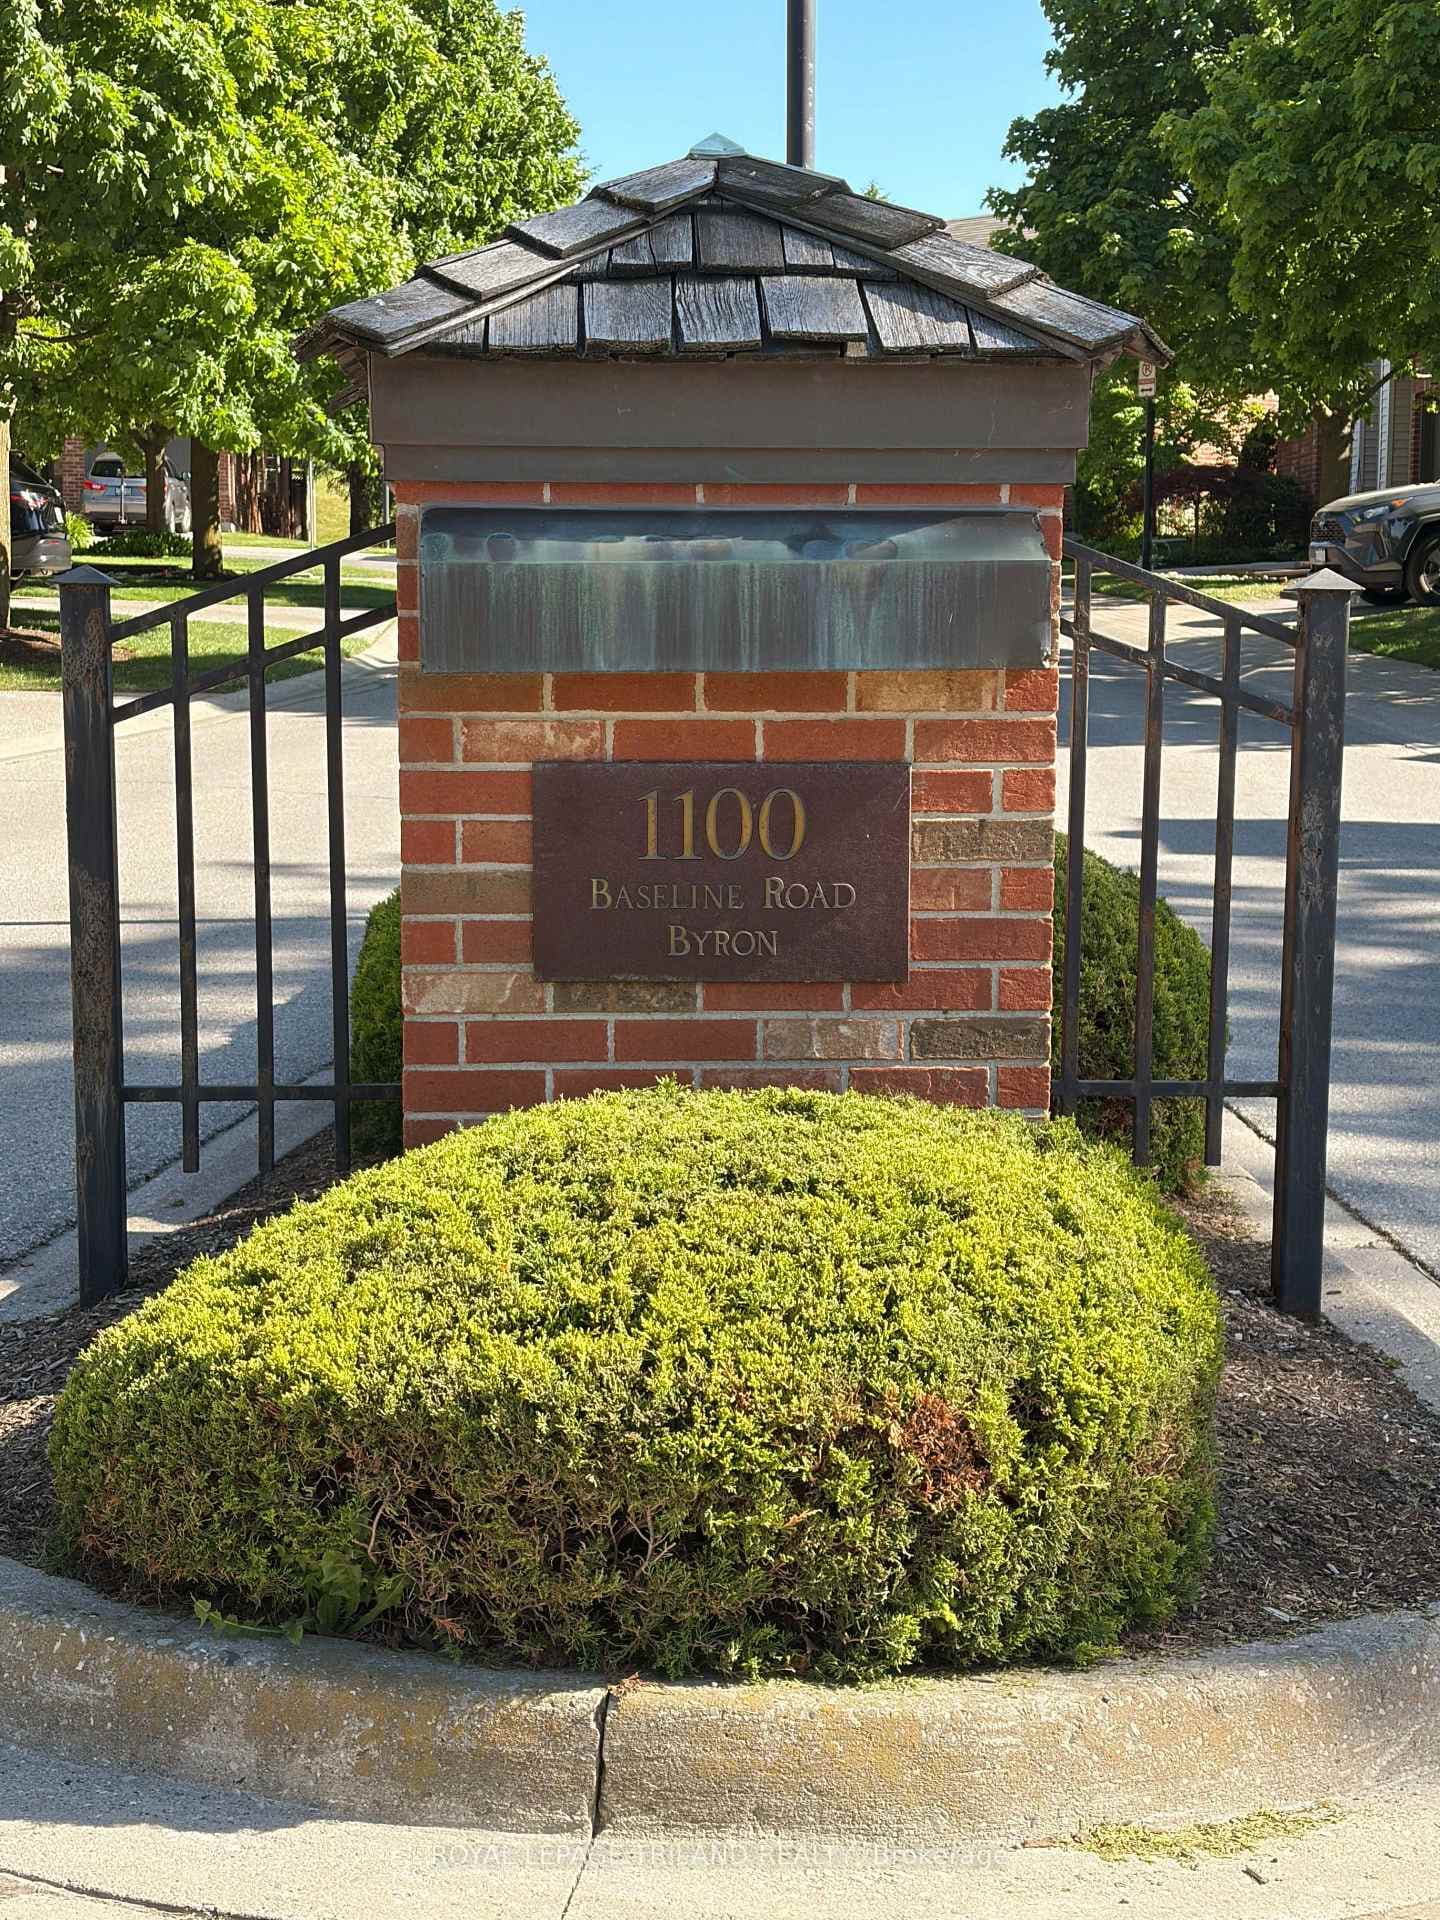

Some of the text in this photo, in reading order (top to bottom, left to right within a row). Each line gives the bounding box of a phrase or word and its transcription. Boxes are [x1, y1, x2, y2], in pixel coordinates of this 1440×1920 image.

[637, 787, 807, 861] 1100
[590, 876, 857, 910] BASELINE ROAD
[667, 925, 779, 957] BYRON
